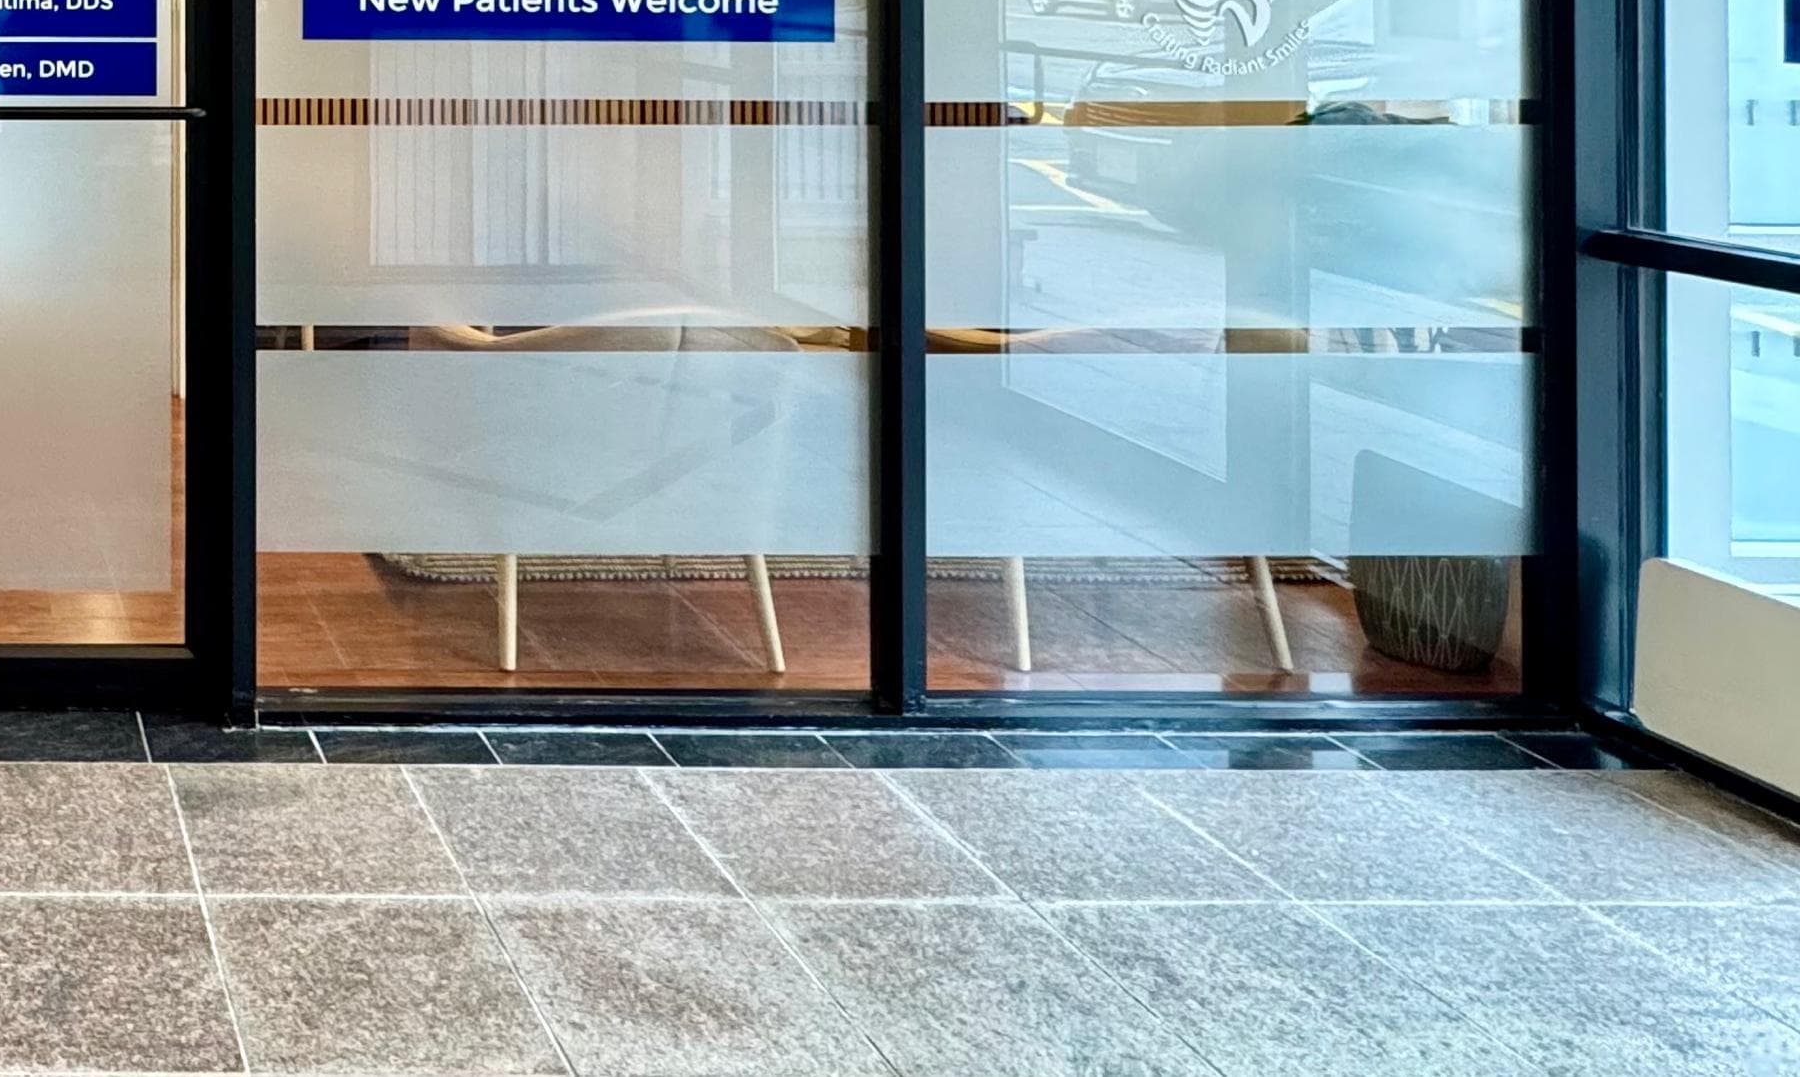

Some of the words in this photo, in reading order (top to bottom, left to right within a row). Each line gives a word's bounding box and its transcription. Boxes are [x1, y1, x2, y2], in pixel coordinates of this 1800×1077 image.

[1141, 13, 1197, 69] Crafting
[1201, 56, 1266, 76] Radiant
[1265, 19, 1311, 67] Smiles
[39, 59, 94, 78] DMD
